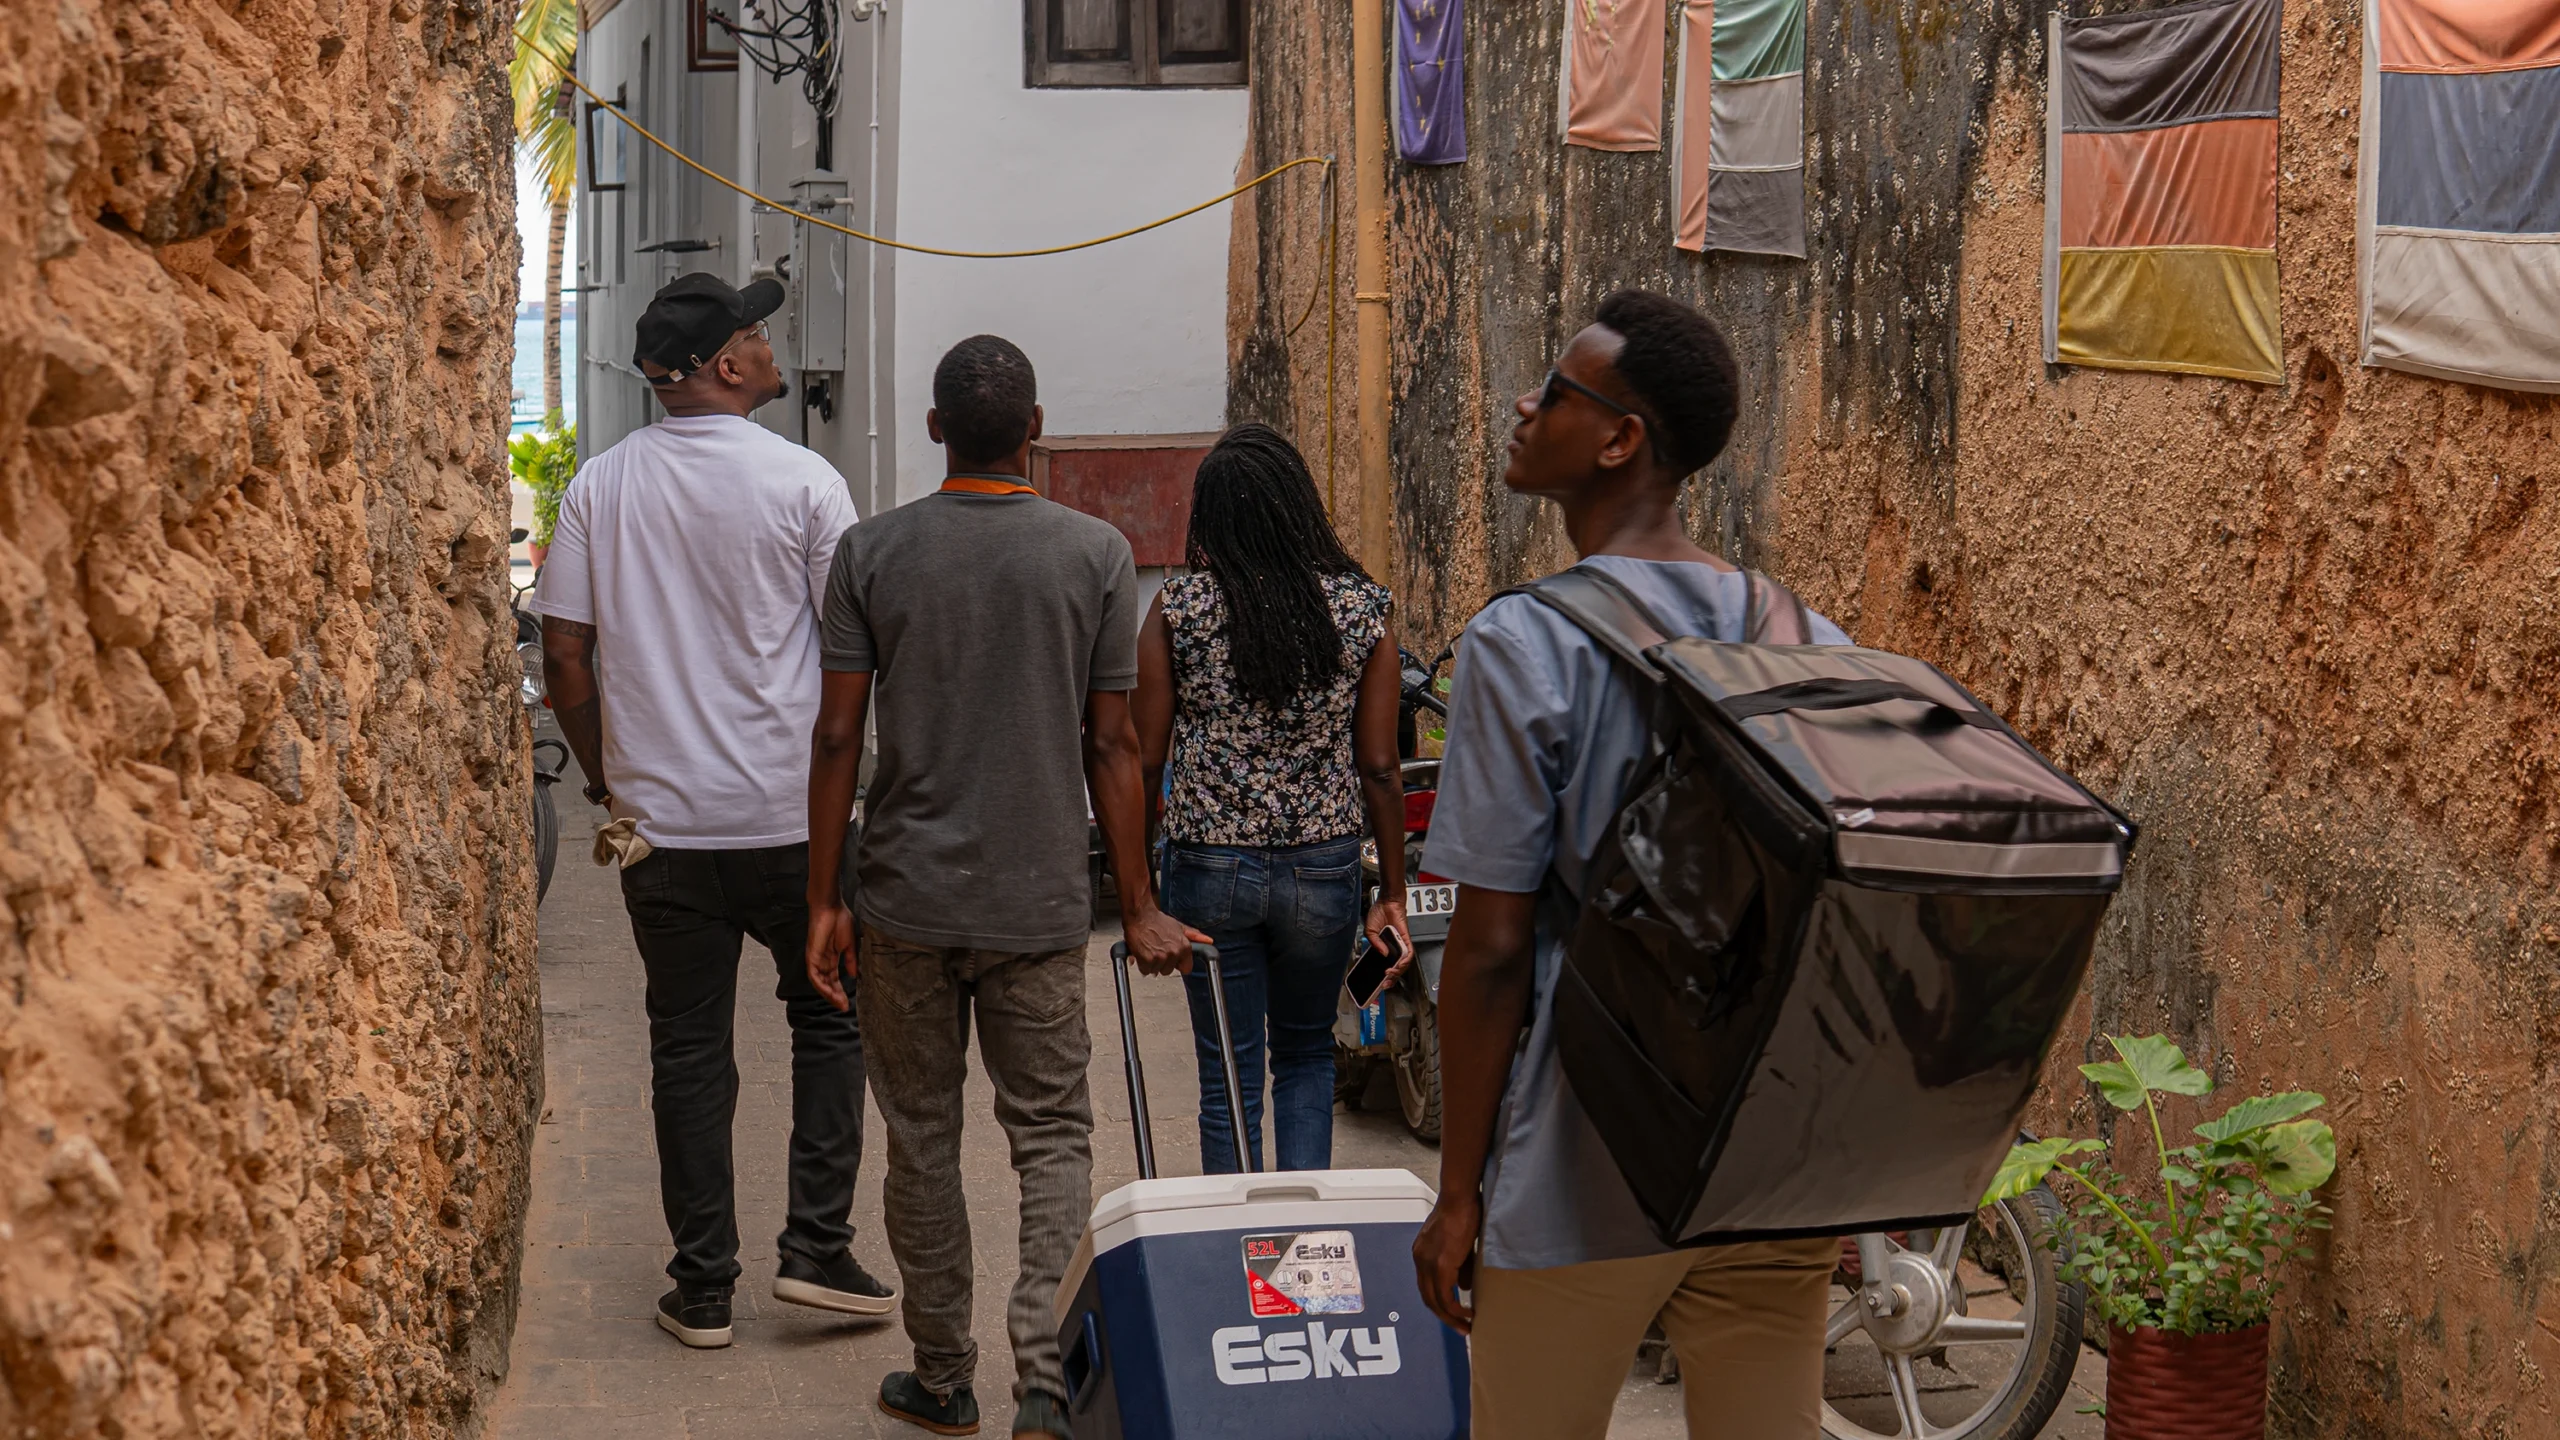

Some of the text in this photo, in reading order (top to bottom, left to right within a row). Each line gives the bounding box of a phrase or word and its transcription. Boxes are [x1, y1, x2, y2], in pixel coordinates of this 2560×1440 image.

[1411, 888, 1453, 912] 133
[1247, 1240, 1280, 1256] 52L
[1295, 1243, 1346, 1260] Esky
[1212, 1321, 1401, 1385] Esky
